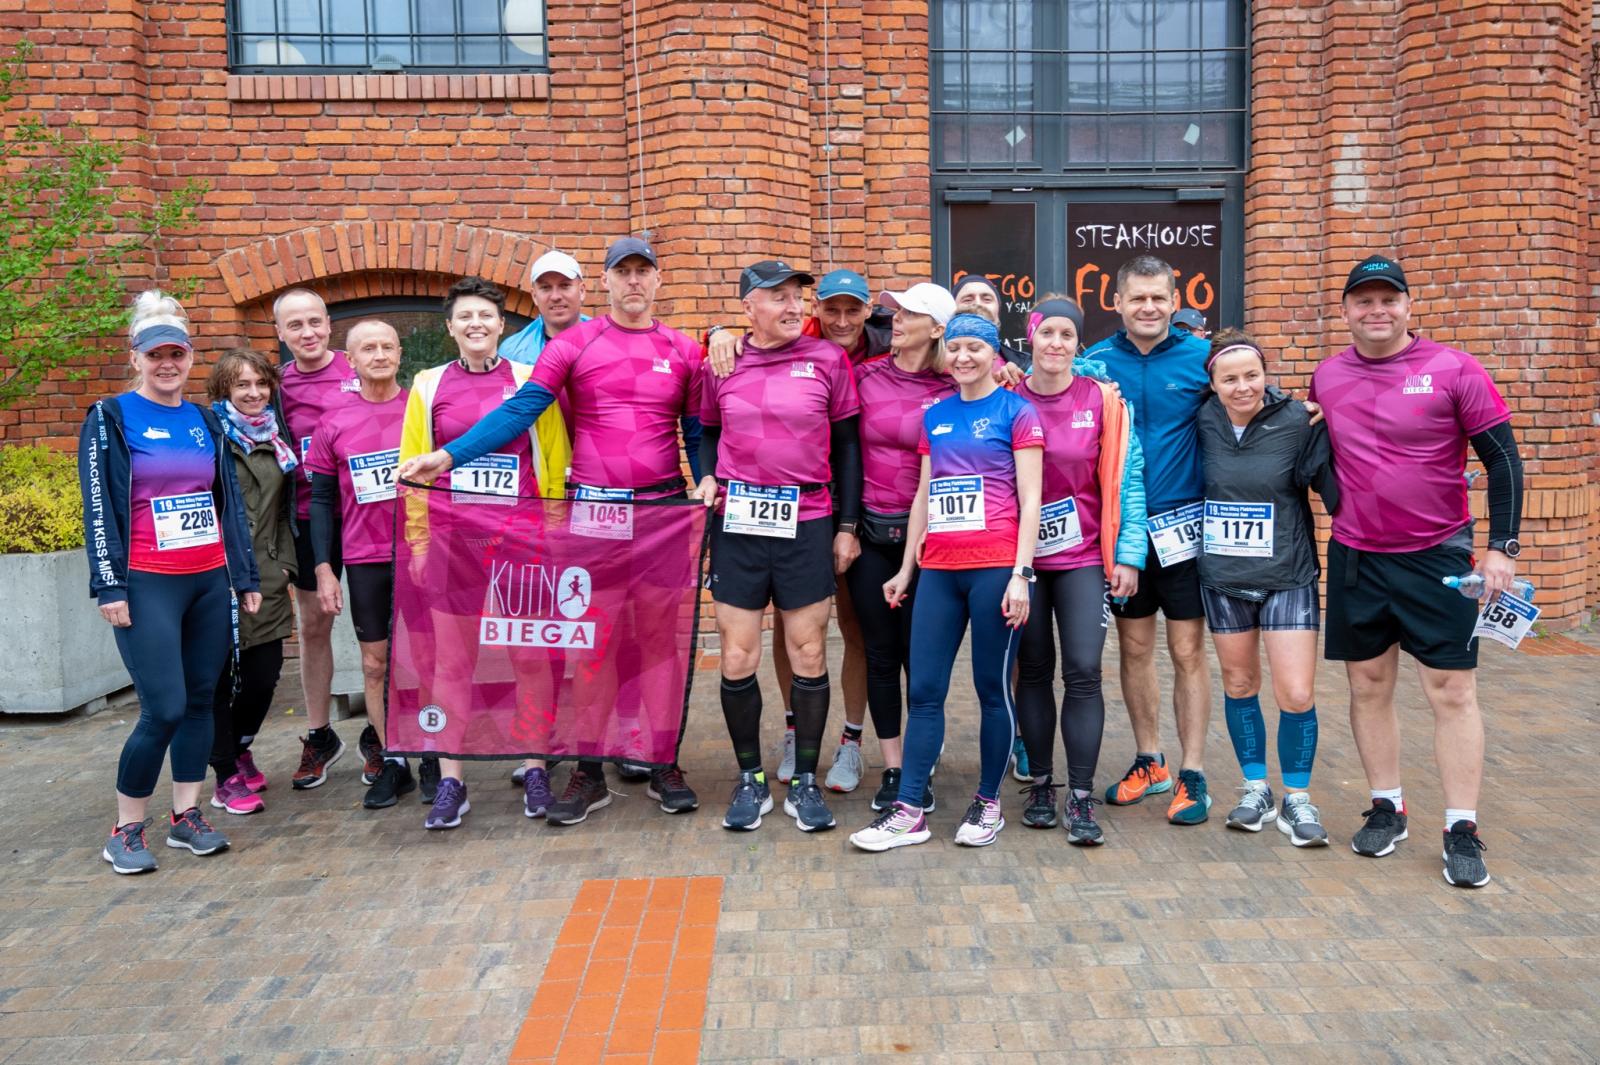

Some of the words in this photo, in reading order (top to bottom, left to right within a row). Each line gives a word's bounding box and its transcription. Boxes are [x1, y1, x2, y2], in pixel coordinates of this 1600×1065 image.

[1075, 223, 1216, 249] STEAKHOUSE
[1075, 263, 1214, 311] FUO
[1005, 302, 1013, 312] Y
[99, 425, 107, 440] KISS
[354, 458, 368, 469] 19.
[371, 465, 398, 486] 12
[472, 470, 513, 489] 1172
[159, 499, 176, 511] 19.
[589, 504, 627, 524] 1045
[749, 500, 792, 521] 1219
[939, 494, 977, 515] 1017
[1209, 504, 1220, 516] 19.
[180, 509, 214, 531] 2289
[1038, 517, 1067, 541] 657
[1153, 518, 1168, 530] 19.
[1222, 520, 1263, 540] 1171
[489, 559, 592, 619] KUTNO
[485, 620, 588, 645] BIEGA
[427, 712, 439, 727] B
[1236, 706, 1257, 759] Kalenji
[1295, 721, 1317, 768] Kalenji
